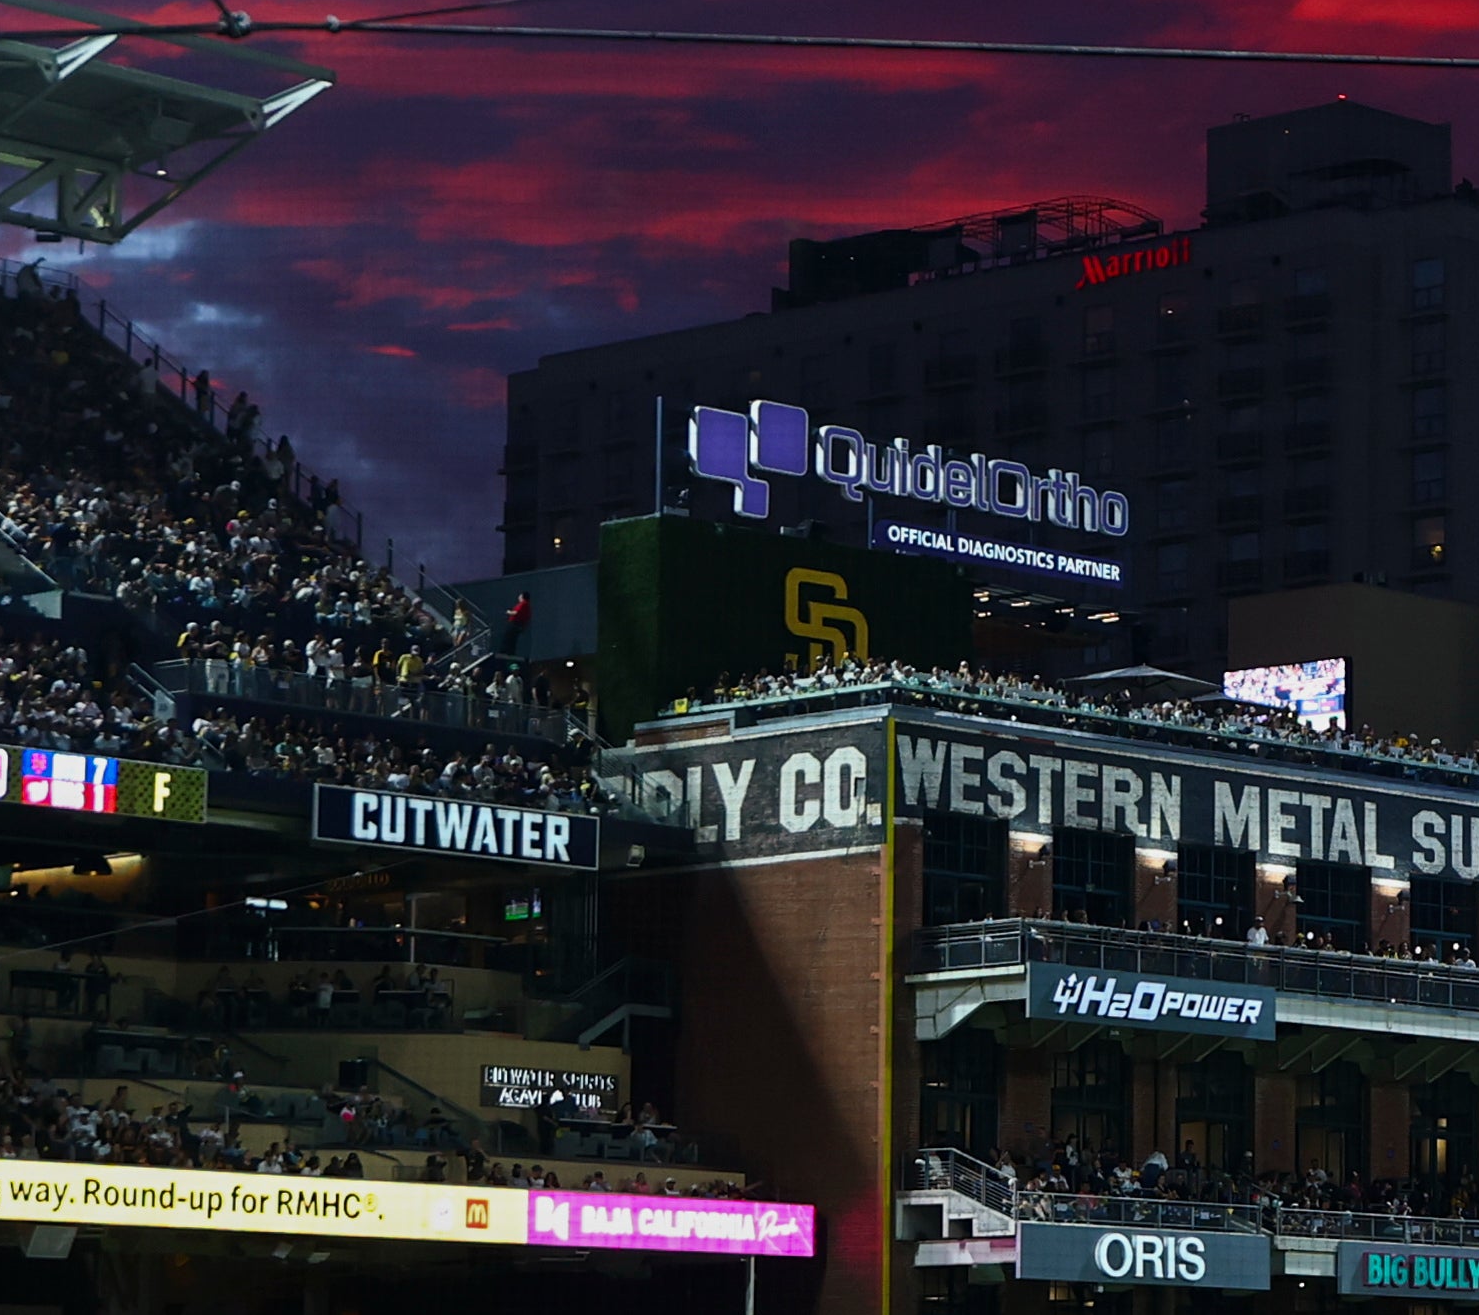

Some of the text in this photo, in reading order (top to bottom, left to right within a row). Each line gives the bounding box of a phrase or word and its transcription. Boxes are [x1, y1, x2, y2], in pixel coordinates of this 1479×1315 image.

[1074, 236, 1191, 290] Marriott
[816, 425, 1130, 536] QuidelOrtho
[887, 525, 1121, 582] OFFICIAL DIAGNOSTICS PARTNER
[153, 772, 171, 813] F
[896, 734, 1182, 841] WESTERN
[1214, 781, 1396, 870] METAL
[352, 792, 572, 863] CUTWATER
[9, 1180, 77, 1212] way.
[83, 1178, 223, 1217] Round-up
[230, 1180, 270, 1214] for
[638, 1208, 757, 1242] CALIFORNIA
[1094, 1231, 1206, 1282] ORIS
[1362, 1251, 1409, 1287] BIG
